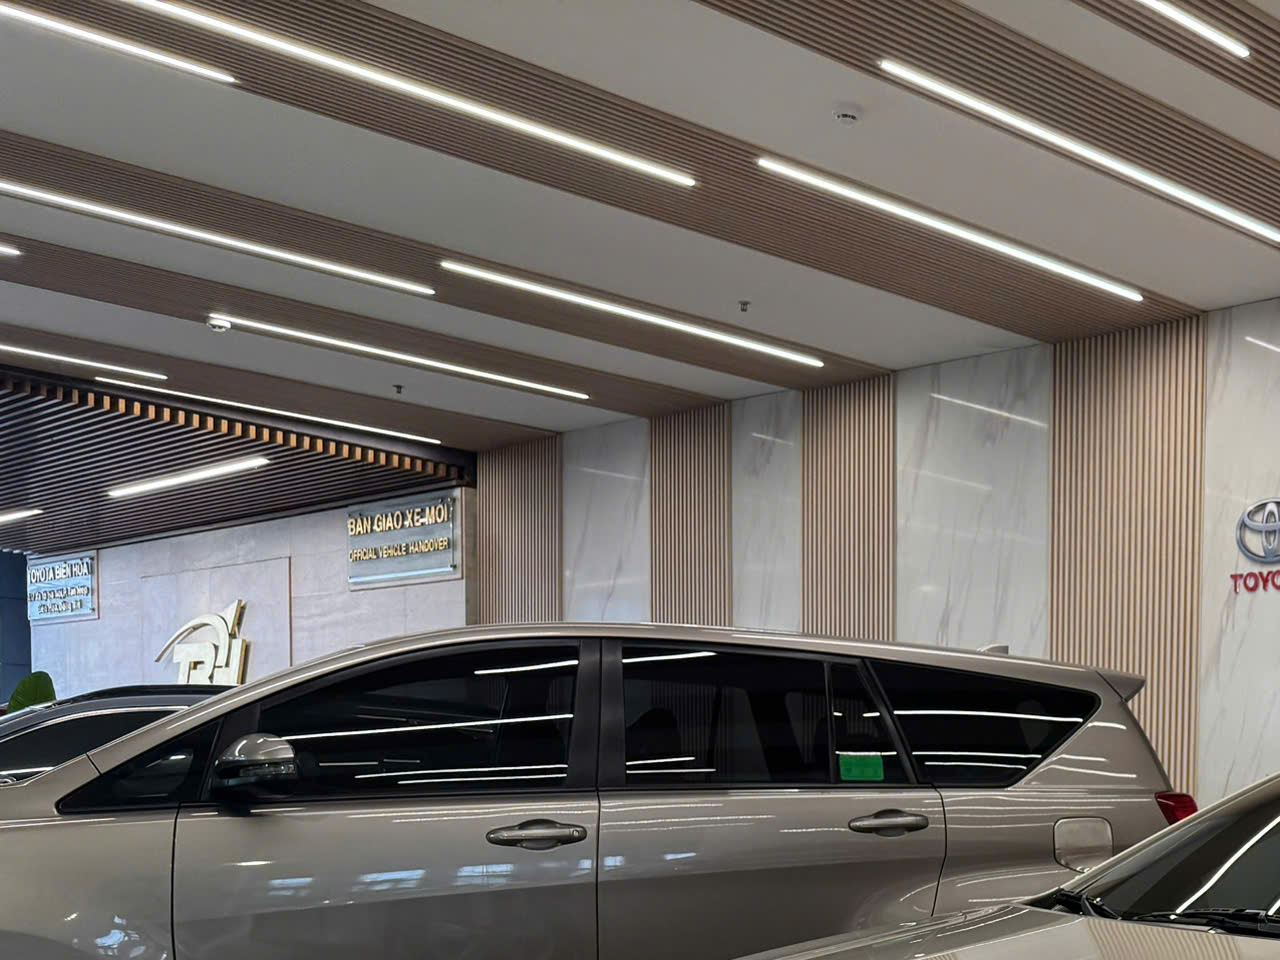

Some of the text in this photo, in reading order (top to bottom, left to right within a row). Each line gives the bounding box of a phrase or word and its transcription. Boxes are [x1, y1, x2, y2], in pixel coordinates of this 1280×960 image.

[374, 511, 402, 533] GIAO
[405, 508, 422, 528] XE
[349, 537, 449, 561] OFFICIAL VEHICLE HANDOVER
